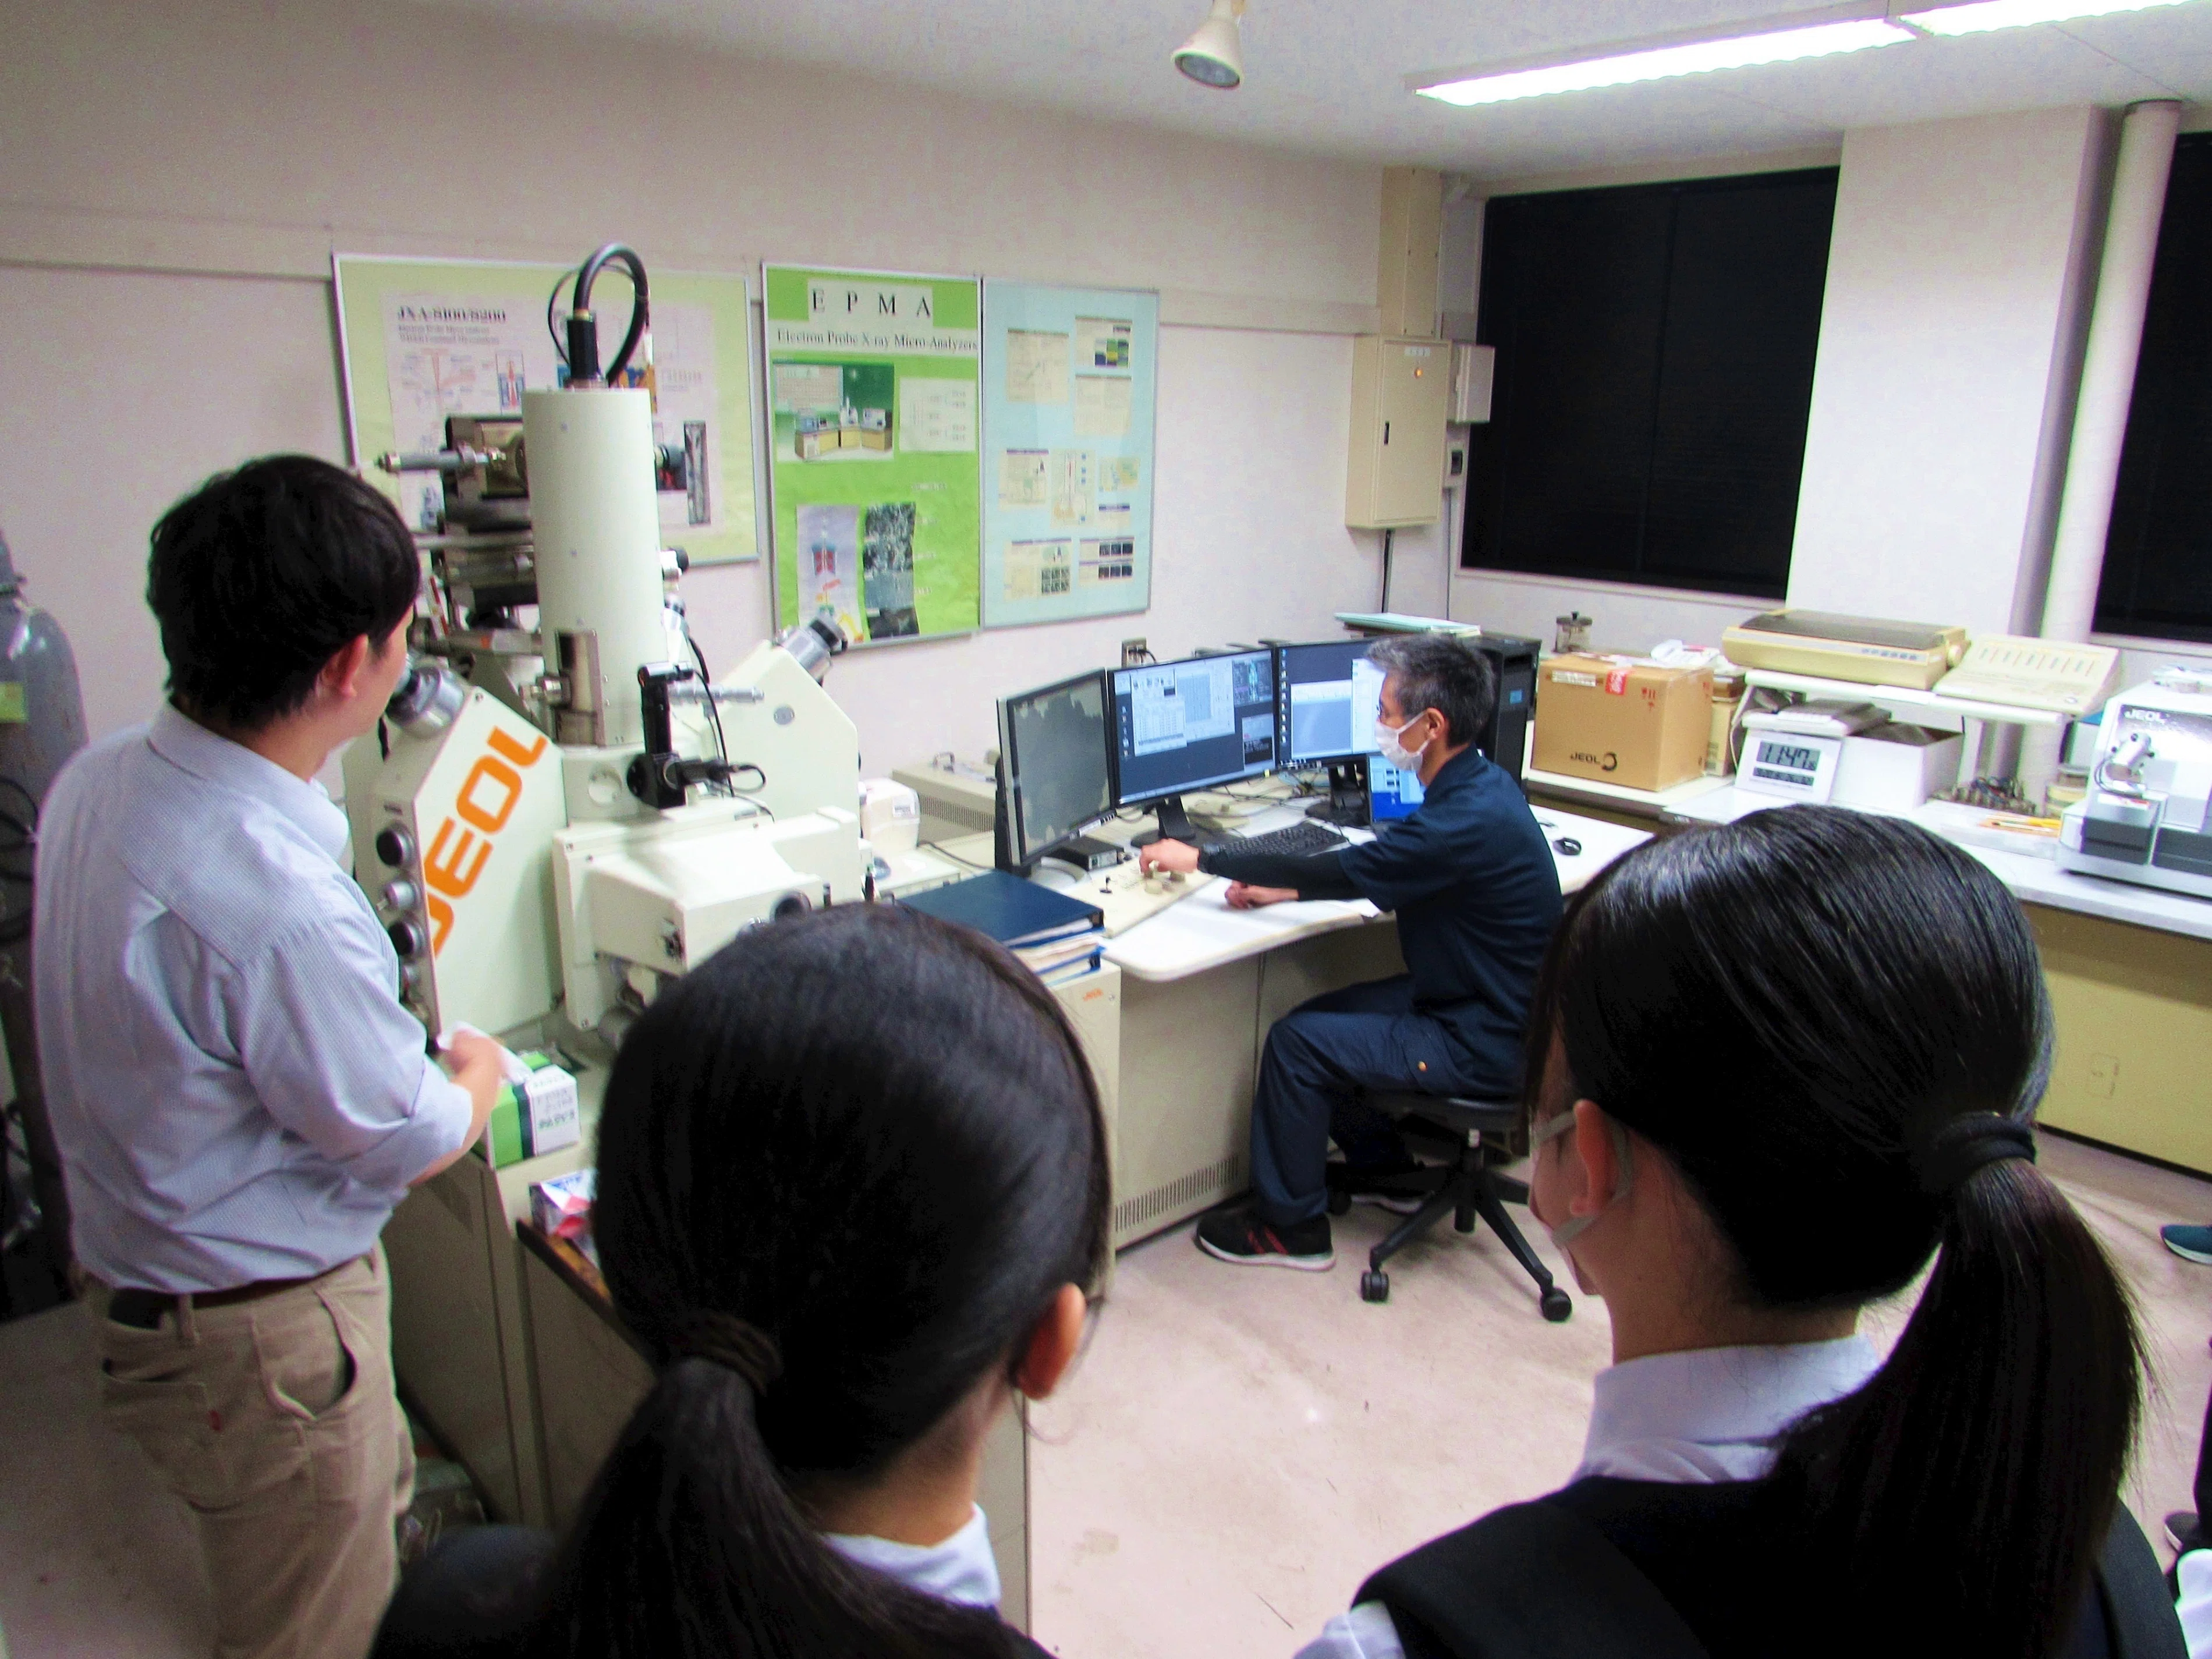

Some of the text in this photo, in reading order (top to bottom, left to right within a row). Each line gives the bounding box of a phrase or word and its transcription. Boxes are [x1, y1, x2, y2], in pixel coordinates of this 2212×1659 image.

[777, 328, 824, 348] Electron
[827, 329, 858, 347] Probe
[2124, 708, 2166, 724] JEOL
[1570, 751, 1601, 765] JEOL
[423, 725, 547, 960] JEOL
